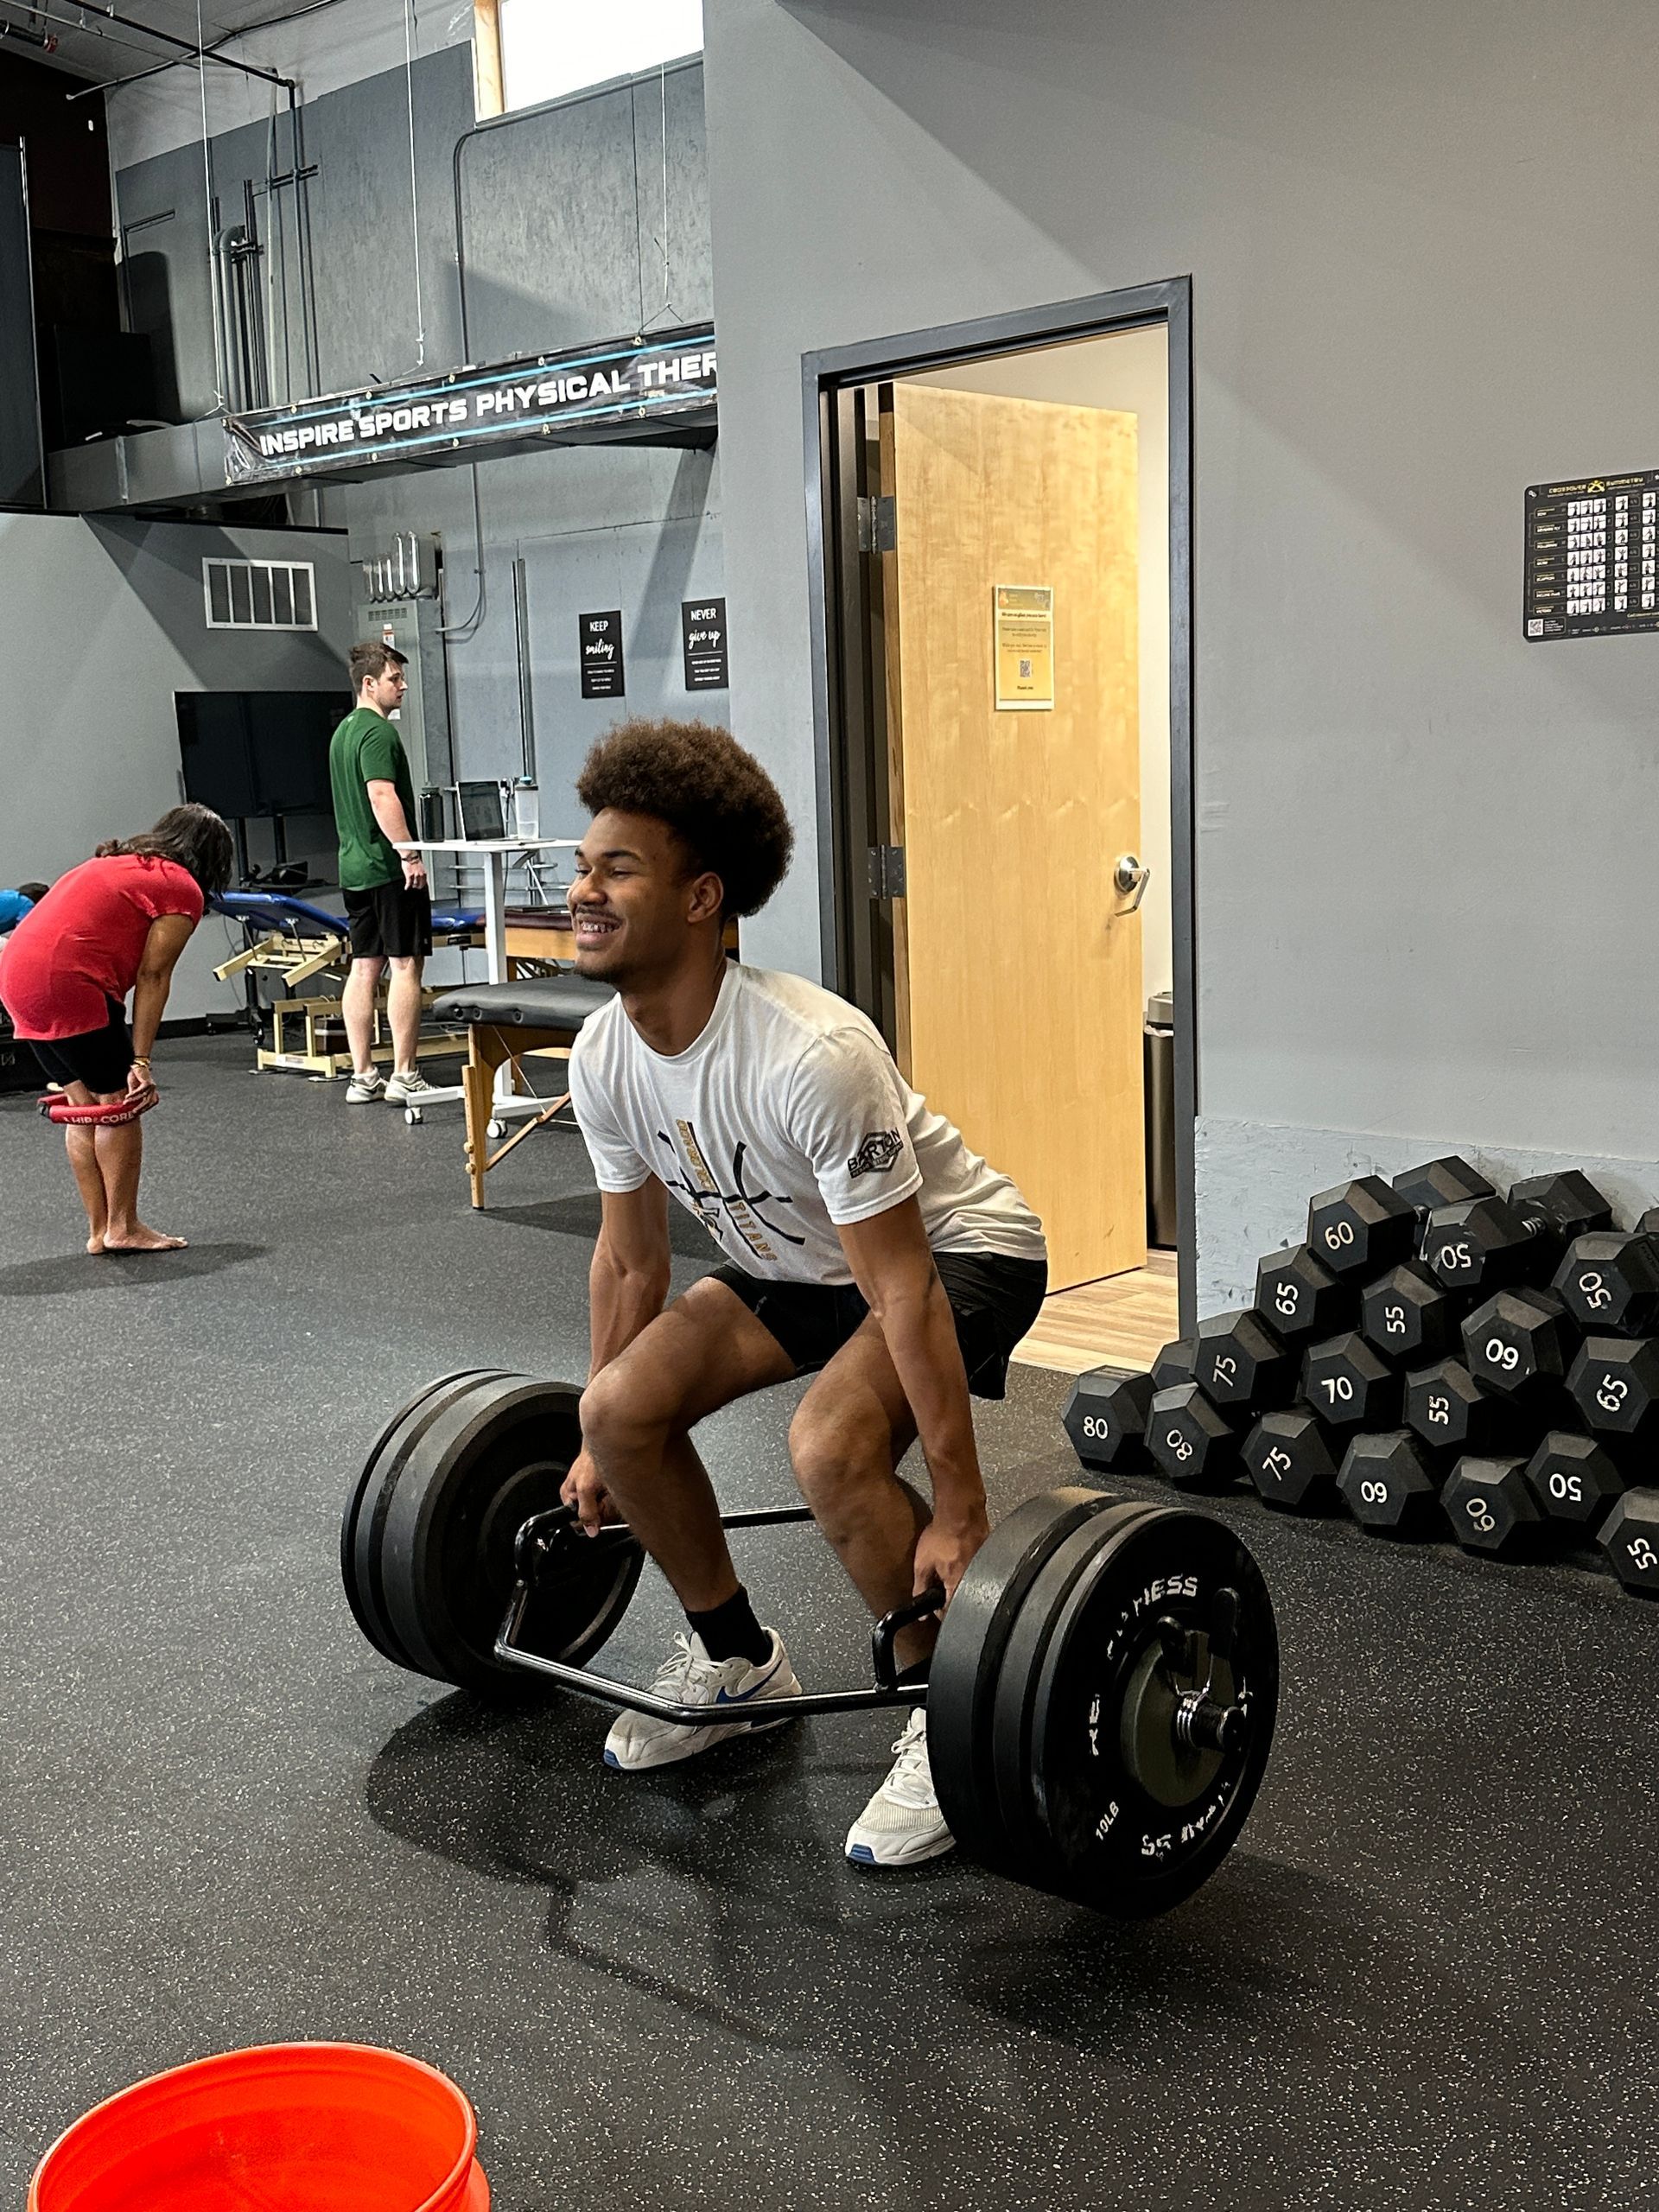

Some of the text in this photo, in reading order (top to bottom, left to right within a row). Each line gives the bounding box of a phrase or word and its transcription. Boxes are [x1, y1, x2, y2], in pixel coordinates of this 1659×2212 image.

[259, 420, 355, 457] INSPIRE
[360, 400, 467, 438] SPORTS
[477, 369, 631, 416] PHYSICAL
[589, 620, 609, 632] KEEP
[690, 607, 717, 621] NEVER
[585, 638, 615, 661] smiling
[688, 629, 721, 650] give up
[1324, 1221, 1355, 1250] 60
[1440, 1243, 1472, 1269] 50
[1274, 1282, 1299, 1315] 65
[1579, 1272, 1612, 1309] 50
[1384, 1306, 1406, 1334] 55
[1212, 1354, 1236, 1387] 75
[1320, 1376, 1353, 1404] 70
[1596, 1374, 1628, 1412] 65
[1428, 1395, 1449, 1426] 55
[1083, 1415, 1109, 1440] 80
[1262, 1446, 1292, 1481] 75
[1549, 1472, 1582, 1502] 50
[1626, 1538, 1658, 1570] 55
[1095, 1801, 1120, 1841] 10LB
